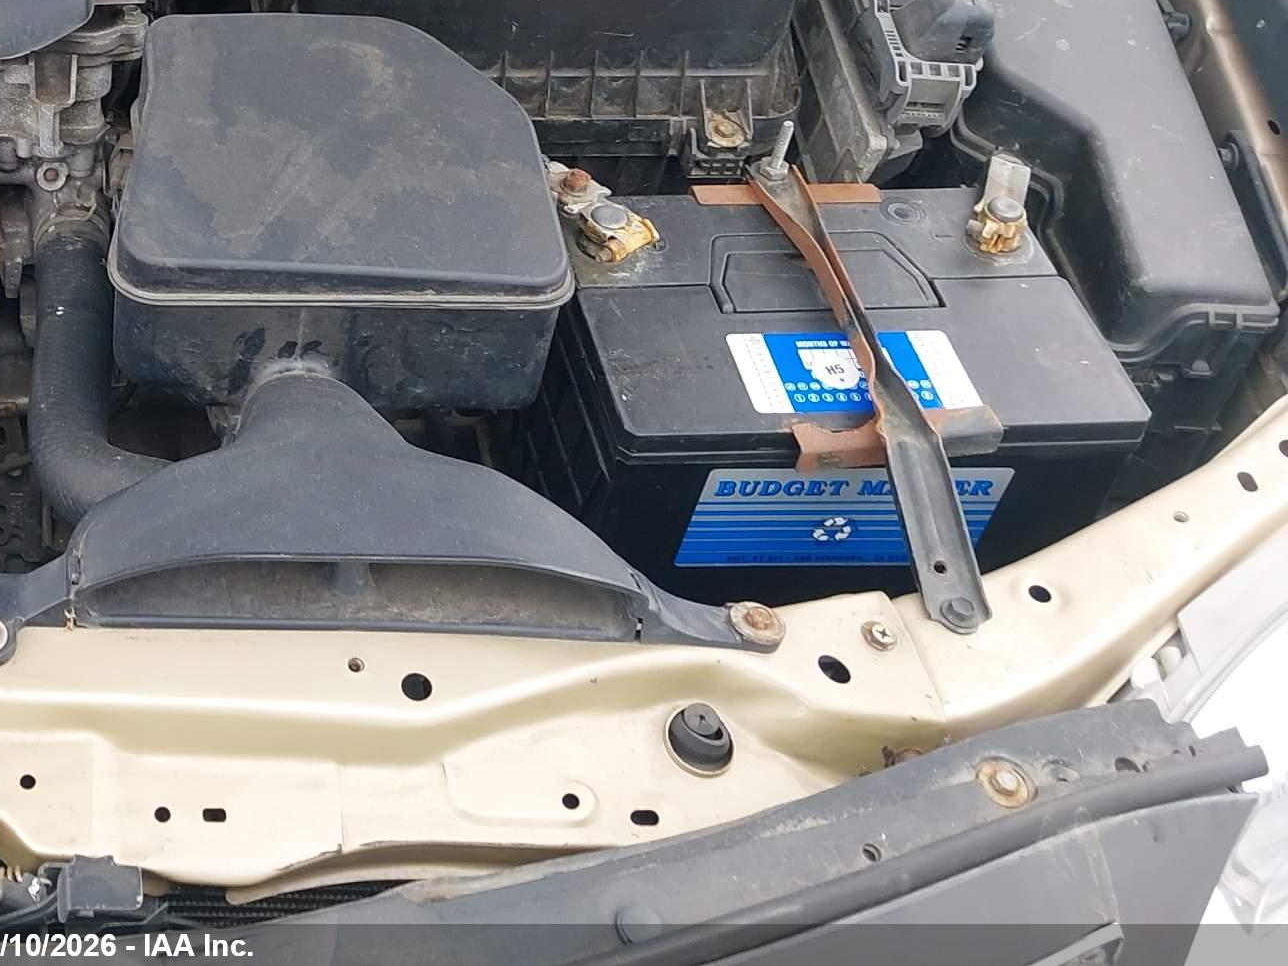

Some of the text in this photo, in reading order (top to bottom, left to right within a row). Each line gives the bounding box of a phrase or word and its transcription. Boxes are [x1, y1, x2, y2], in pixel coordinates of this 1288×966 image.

[825, 364, 845, 376] H5
[714, 479, 994, 497] BUDGET MER
